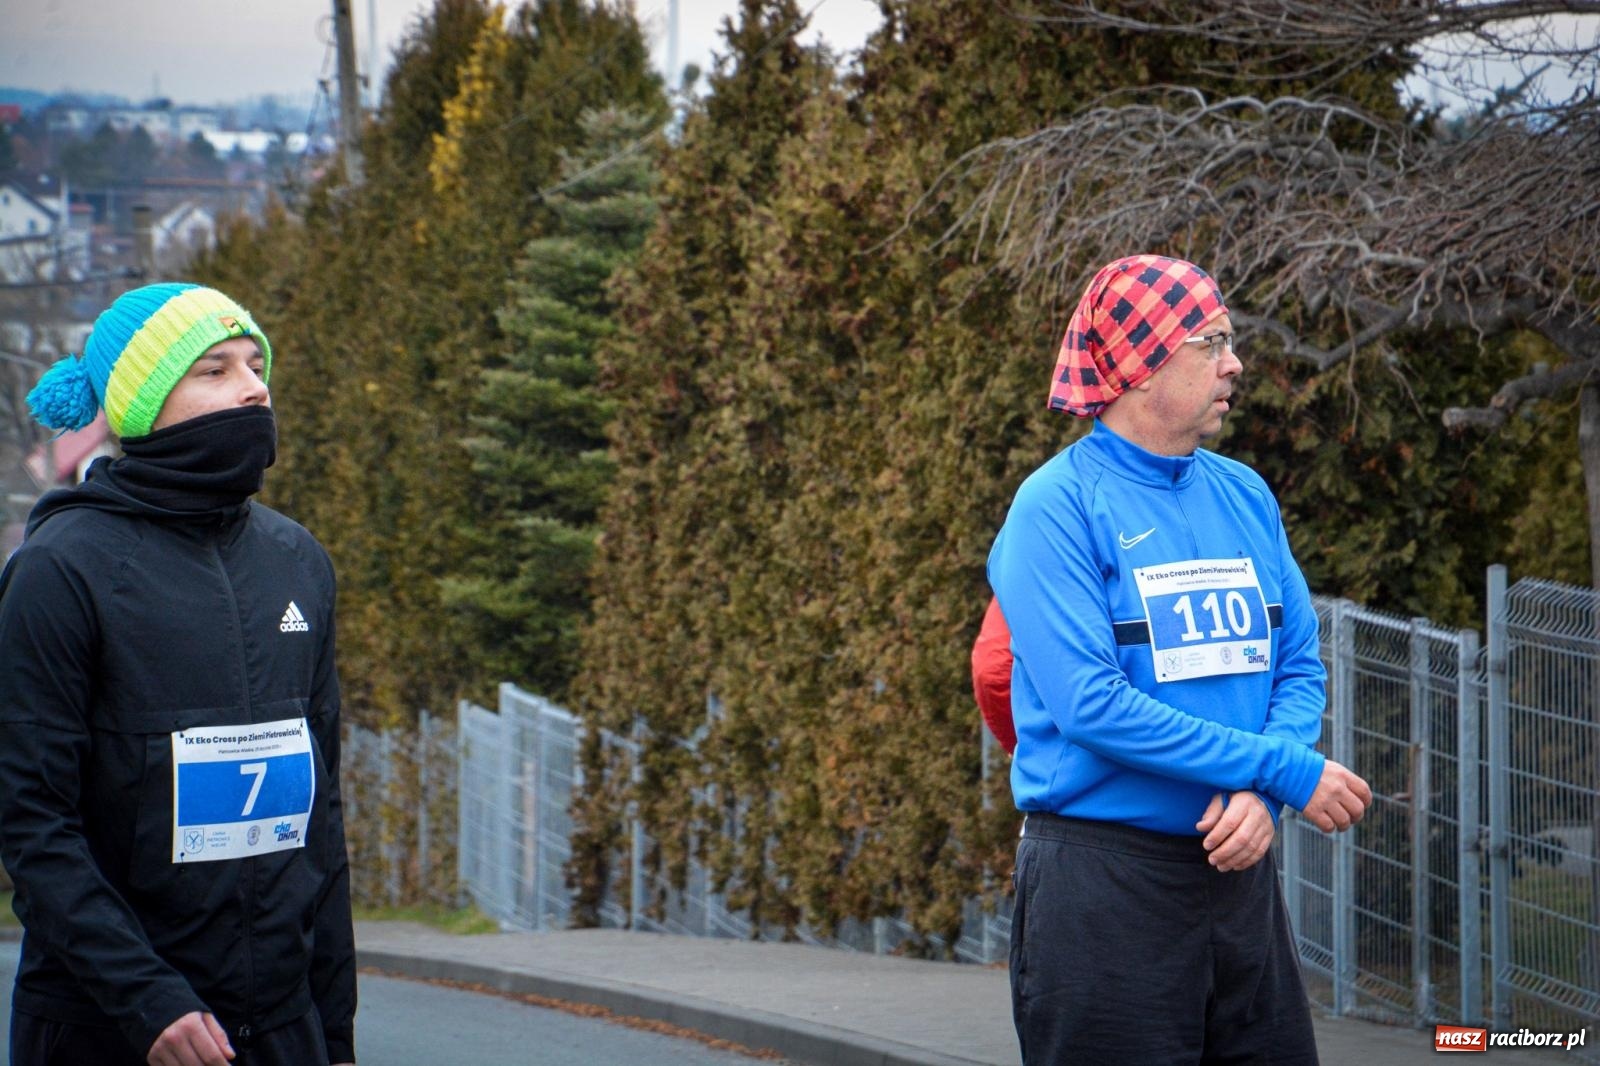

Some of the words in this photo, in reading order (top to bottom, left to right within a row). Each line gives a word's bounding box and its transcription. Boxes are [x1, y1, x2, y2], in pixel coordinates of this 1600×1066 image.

[1156, 573, 1169, 581] Eko
[1169, 570, 1190, 578] Cross
[1190, 569, 1198, 577] po
[1172, 590, 1252, 642] 110
[280, 620, 309, 632] adidas
[196, 736, 212, 744] Eko
[213, 735, 237, 743] Cross
[238, 735, 247, 744] po
[248, 732, 265, 741] Ziemi
[265, 727, 302, 739] Pietrowickiej
[240, 762, 267, 816] 7
